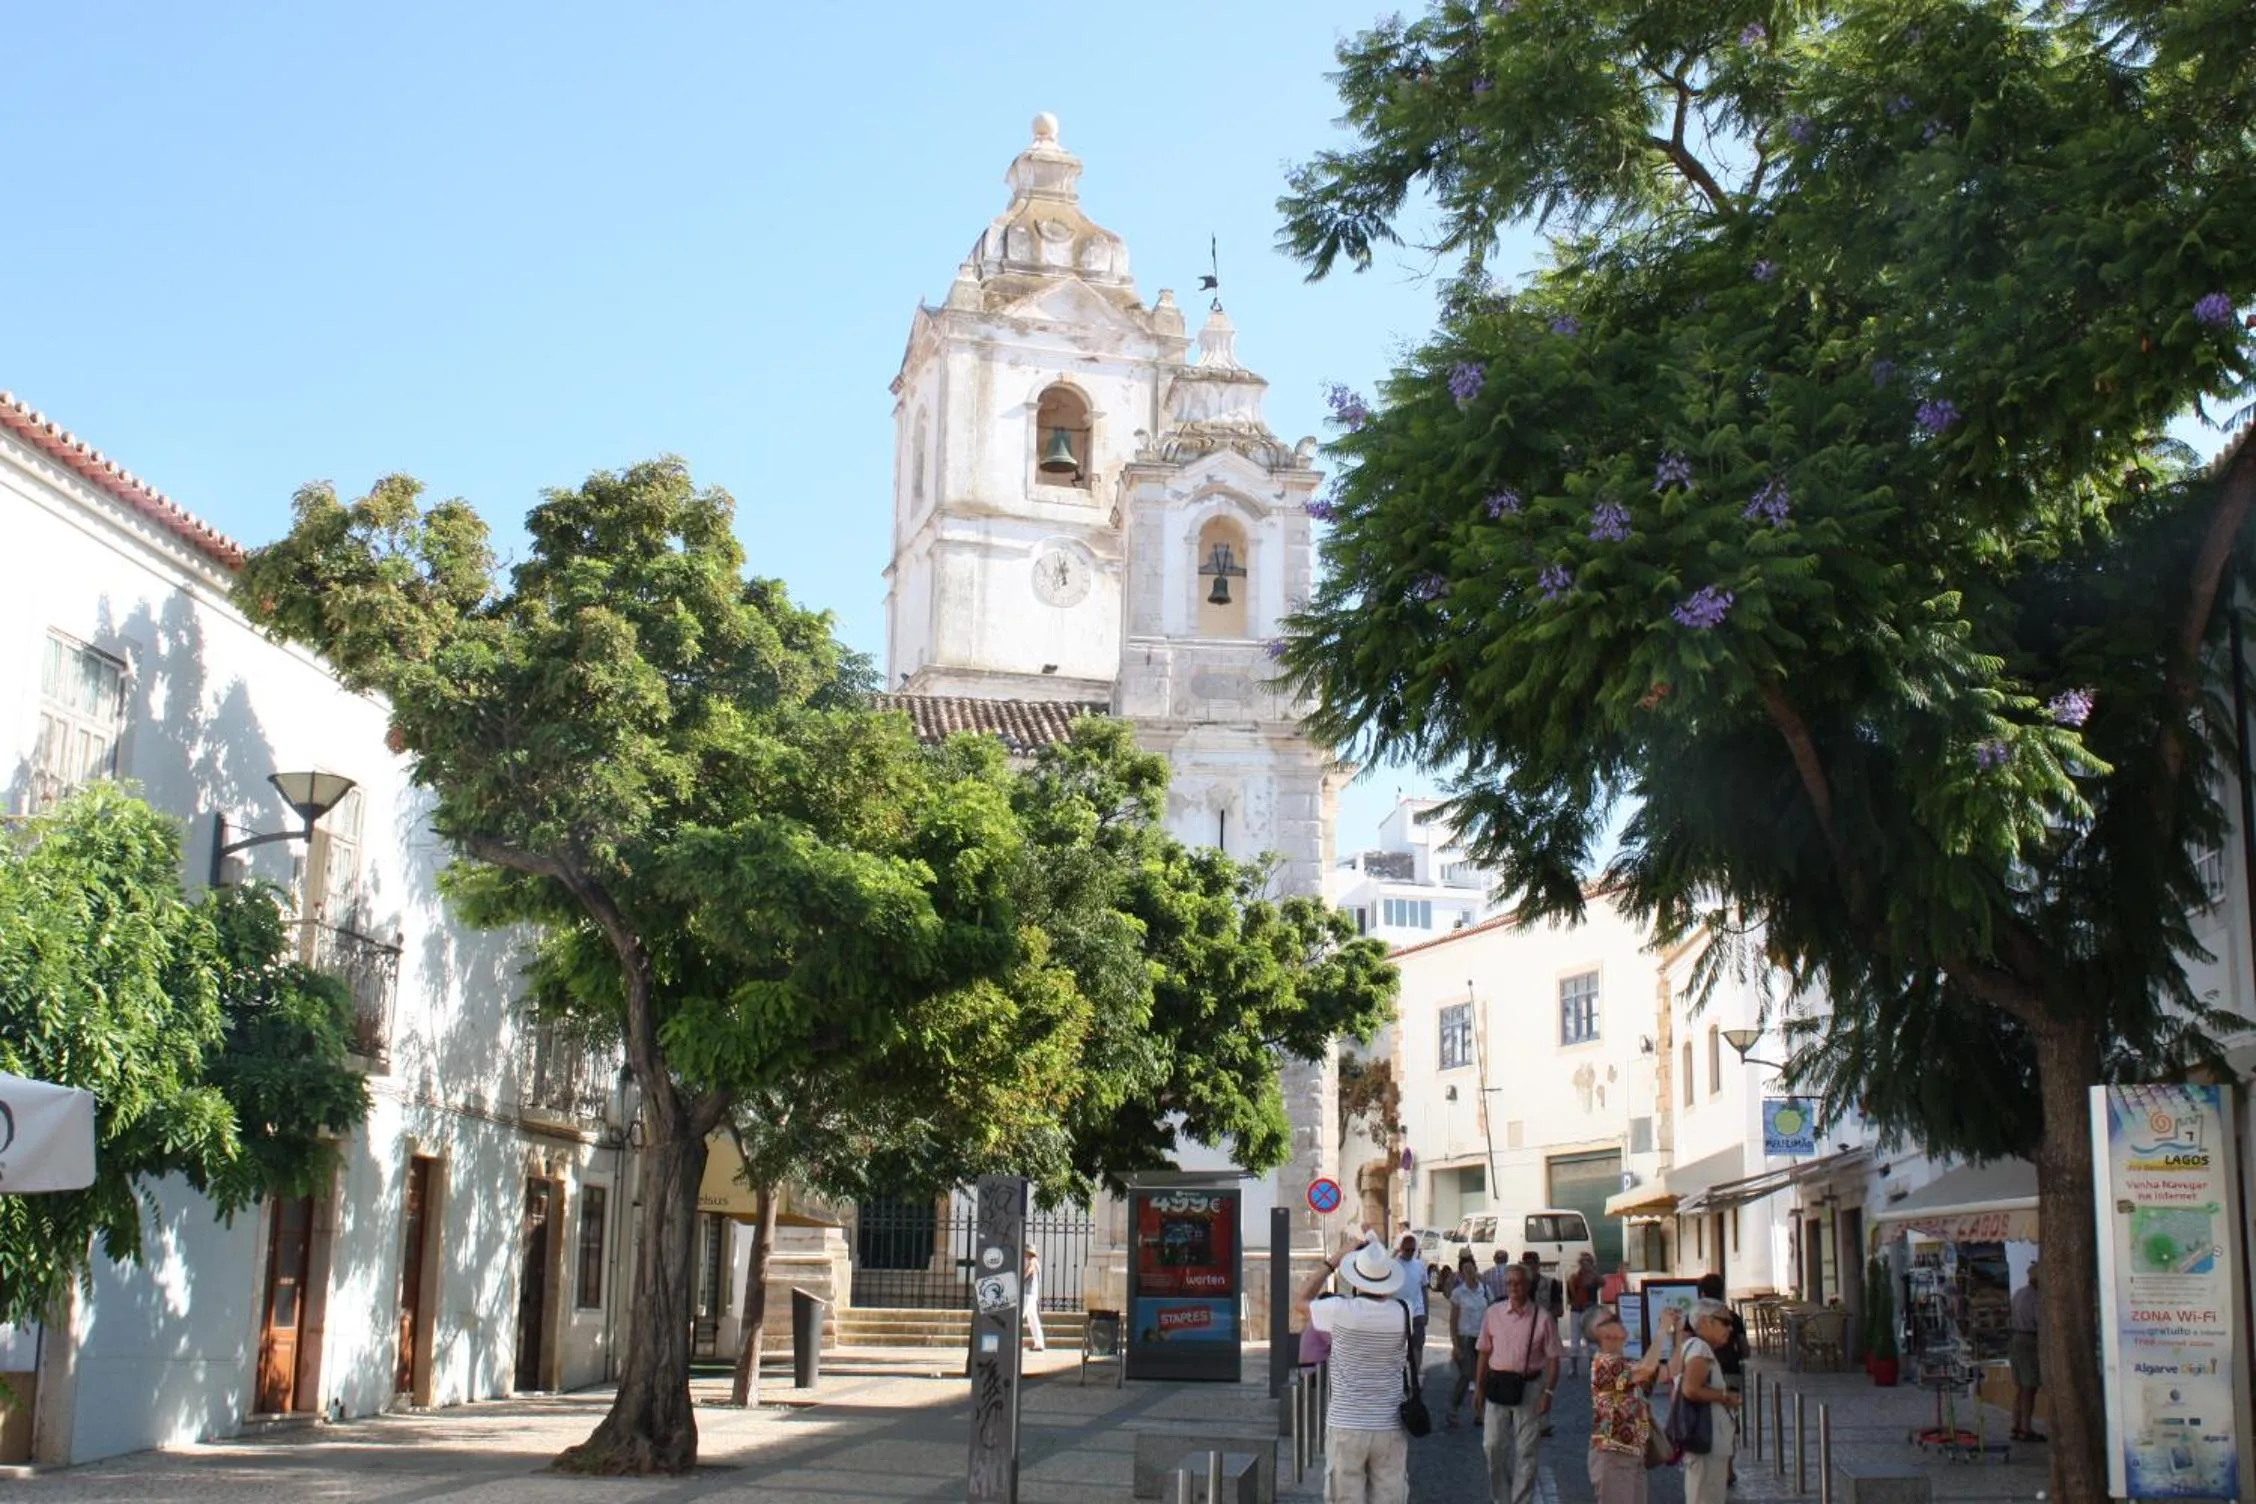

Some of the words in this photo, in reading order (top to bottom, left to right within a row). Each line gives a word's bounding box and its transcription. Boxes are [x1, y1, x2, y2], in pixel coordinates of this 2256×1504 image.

[2165, 1154, 2210, 1165] LAGOS
[1957, 1213, 2010, 1237] LAGOS
[1186, 1275, 1226, 1286] worten
[1160, 1310, 1208, 1325] STAPLES
[2131, 1310, 2172, 1322] ZONA
[2176, 1310, 2217, 1323] Wi-Fi
[2146, 1327, 2191, 1337] gratuito
[2134, 1362, 2178, 1375] Algarve
